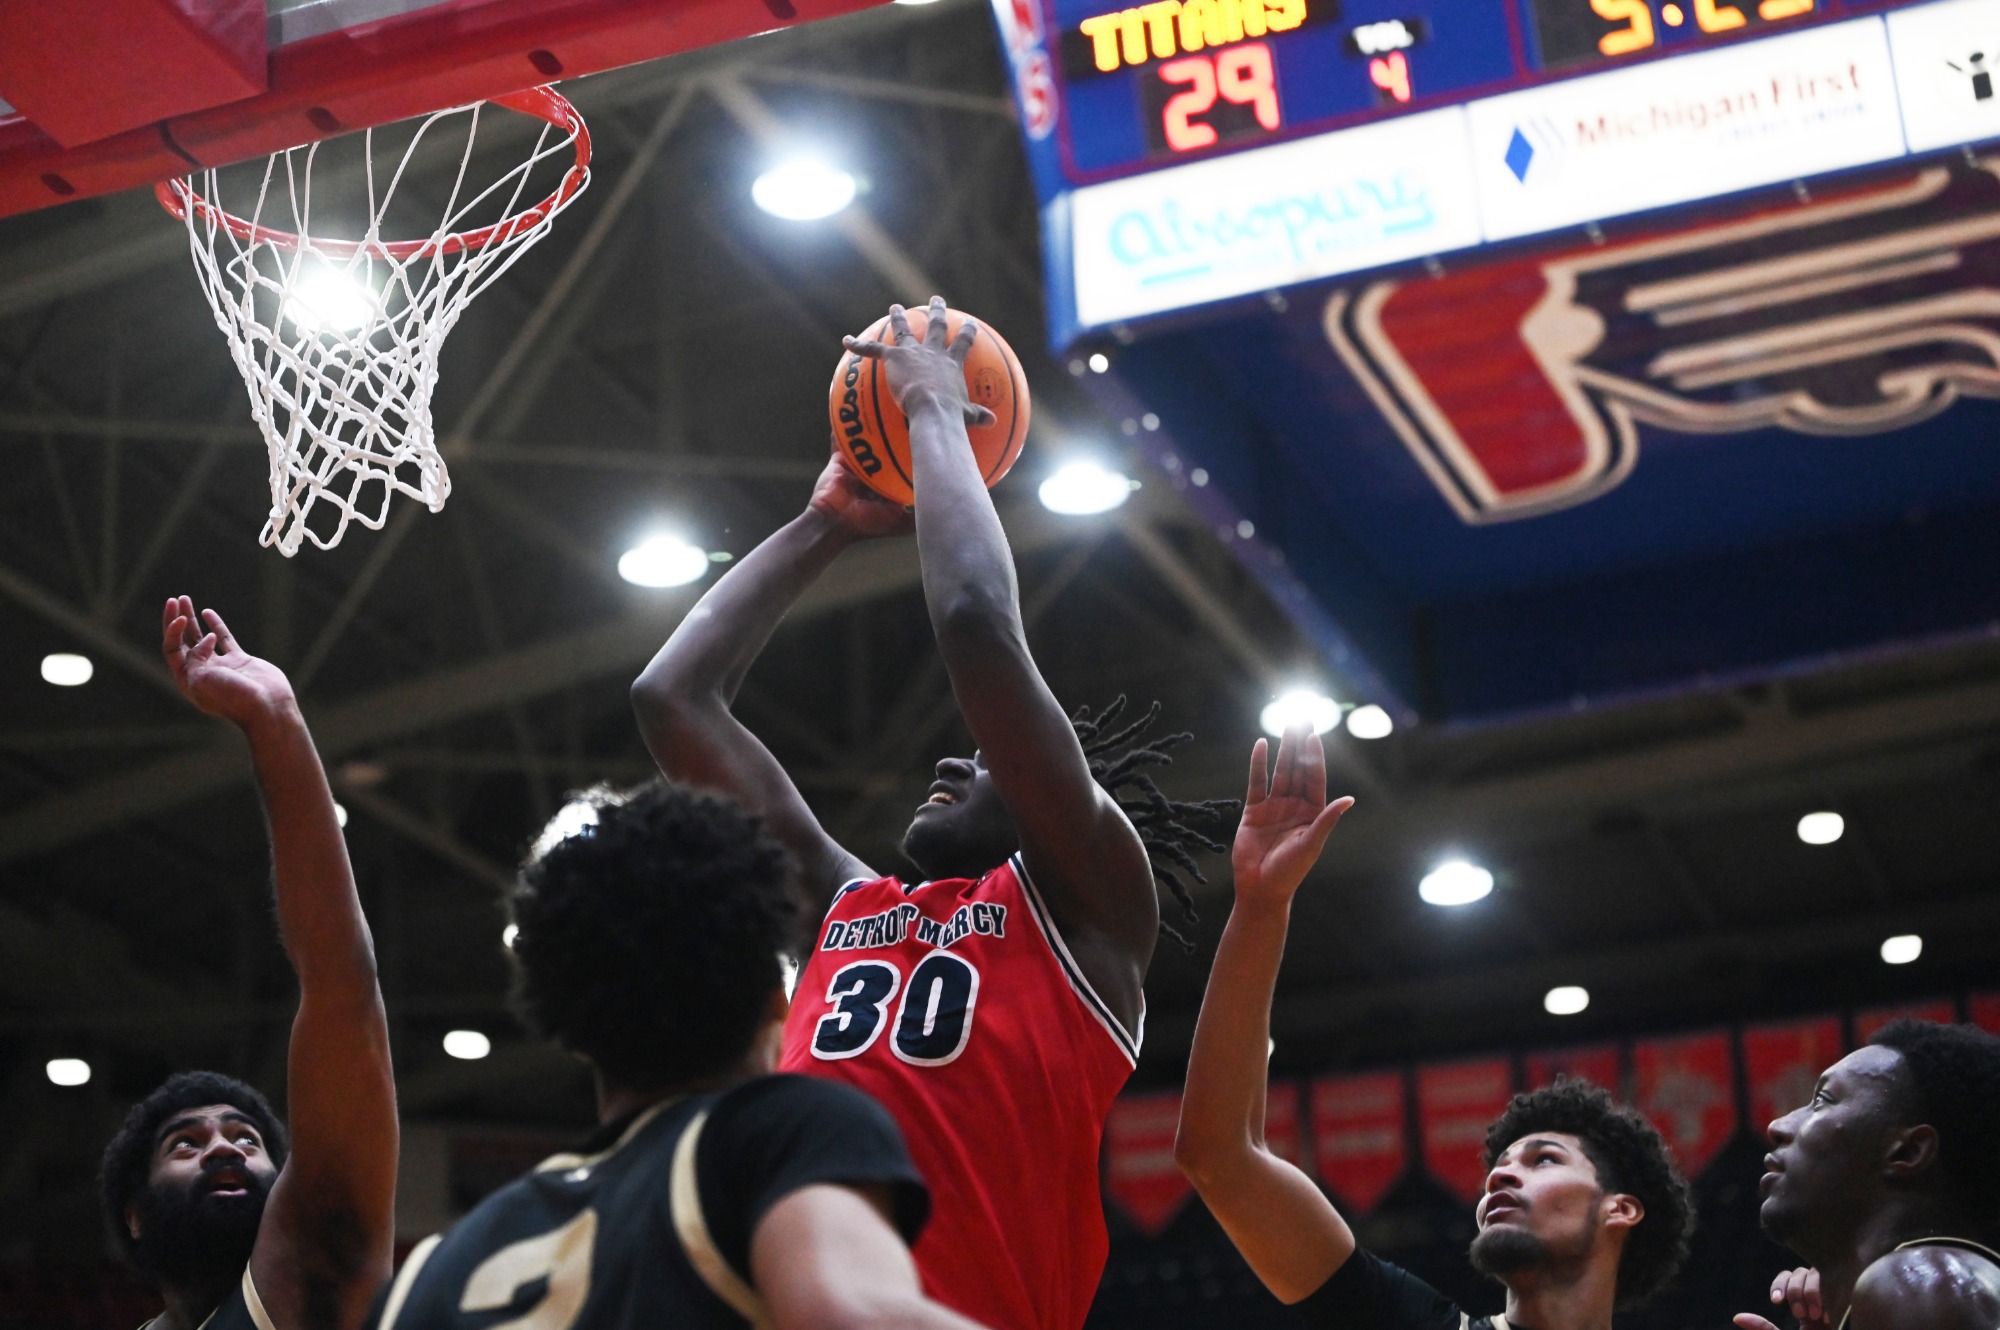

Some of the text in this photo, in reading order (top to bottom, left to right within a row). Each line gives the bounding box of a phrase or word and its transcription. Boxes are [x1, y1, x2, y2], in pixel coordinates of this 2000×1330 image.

[1080, 0, 1307, 71] TITANS
[1158, 42, 1280, 151] 29
[1370, 51, 1411, 102] 4
[1576, 92, 1758, 146] Michigan
[1770, 63, 1861, 106] First
[820, 901, 1007, 951] DETROIT MERCY
[810, 948, 980, 1067] 30
